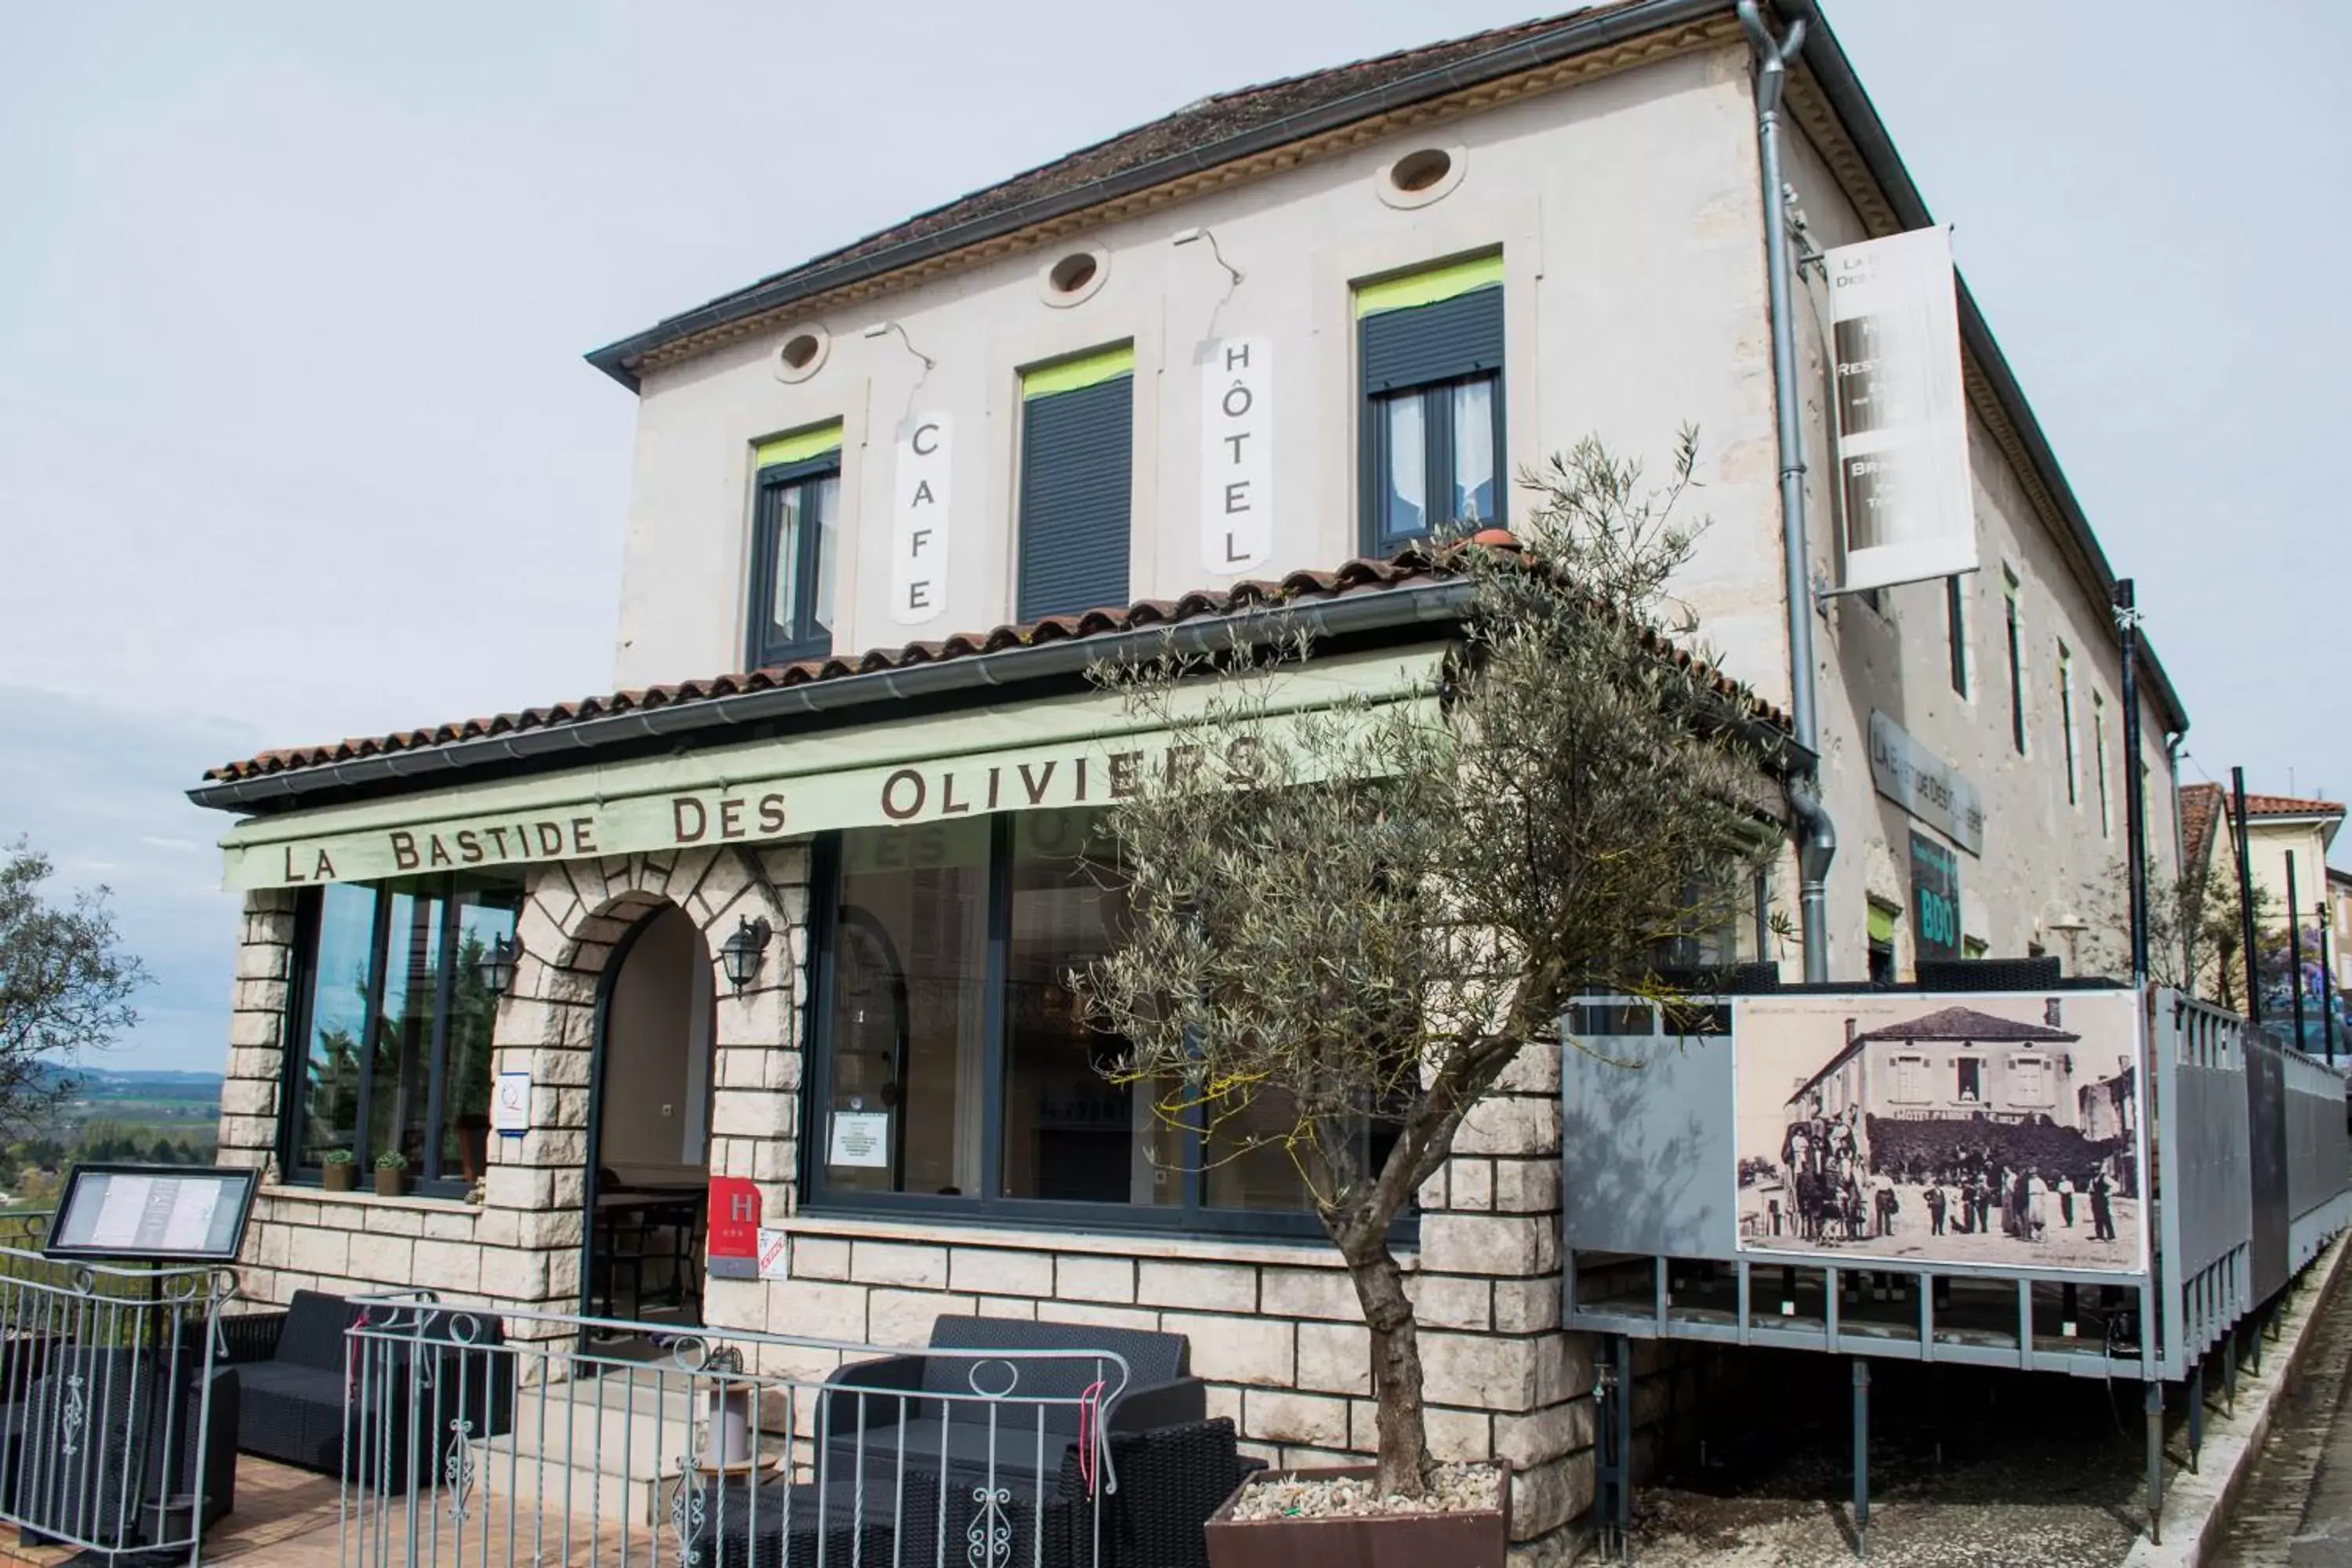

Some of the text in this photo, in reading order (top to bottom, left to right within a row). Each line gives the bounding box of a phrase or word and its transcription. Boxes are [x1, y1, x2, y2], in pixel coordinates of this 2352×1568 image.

[909, 423, 940, 609] CAFE
[1222, 343, 1253, 563] HÔTEL
[284, 846, 337, 882] LA
[390, 816, 597, 870] BASTIDE
[672, 793, 786, 843] DES
[731, 1193, 753, 1222] H
